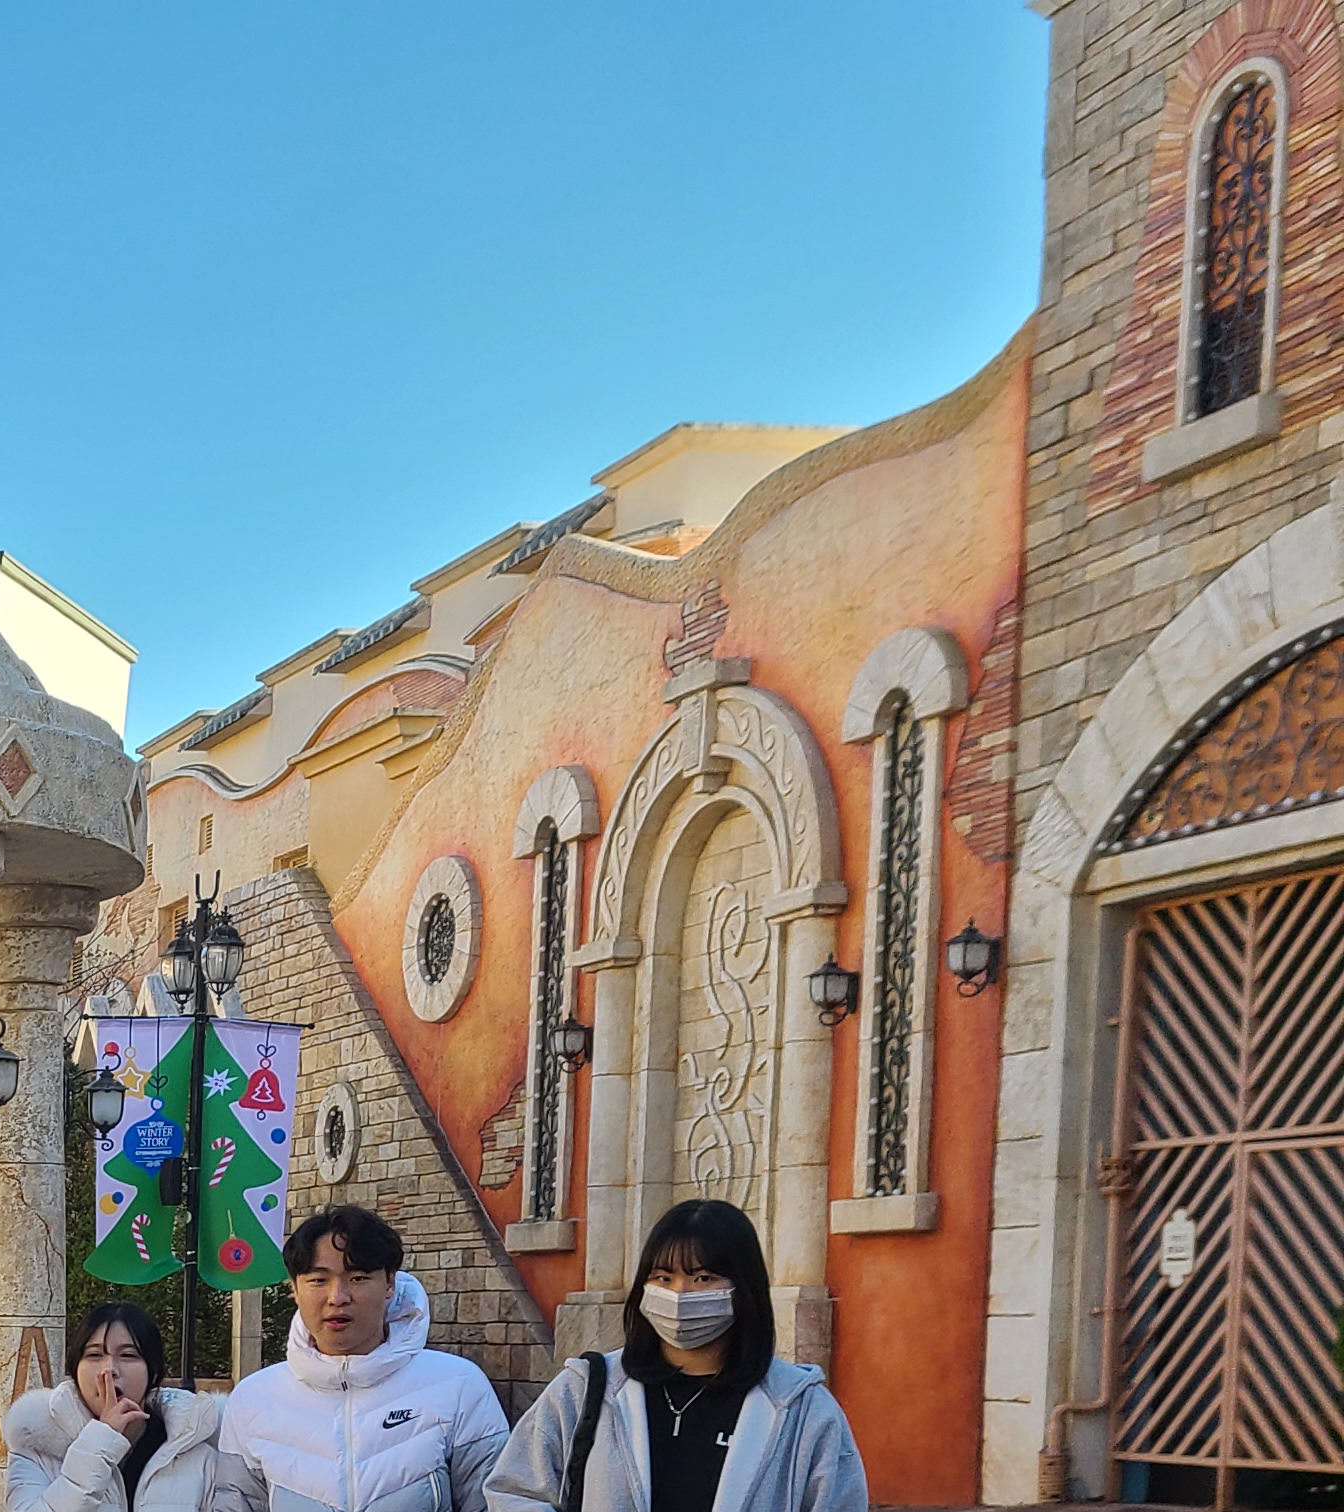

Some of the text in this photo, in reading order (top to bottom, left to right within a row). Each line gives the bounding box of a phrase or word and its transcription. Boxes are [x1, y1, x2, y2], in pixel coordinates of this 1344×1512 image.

[137, 1128, 173, 1138] WINTER
[140, 1137, 169, 1147] STORY
[388, 1408, 413, 1421] NIKE
